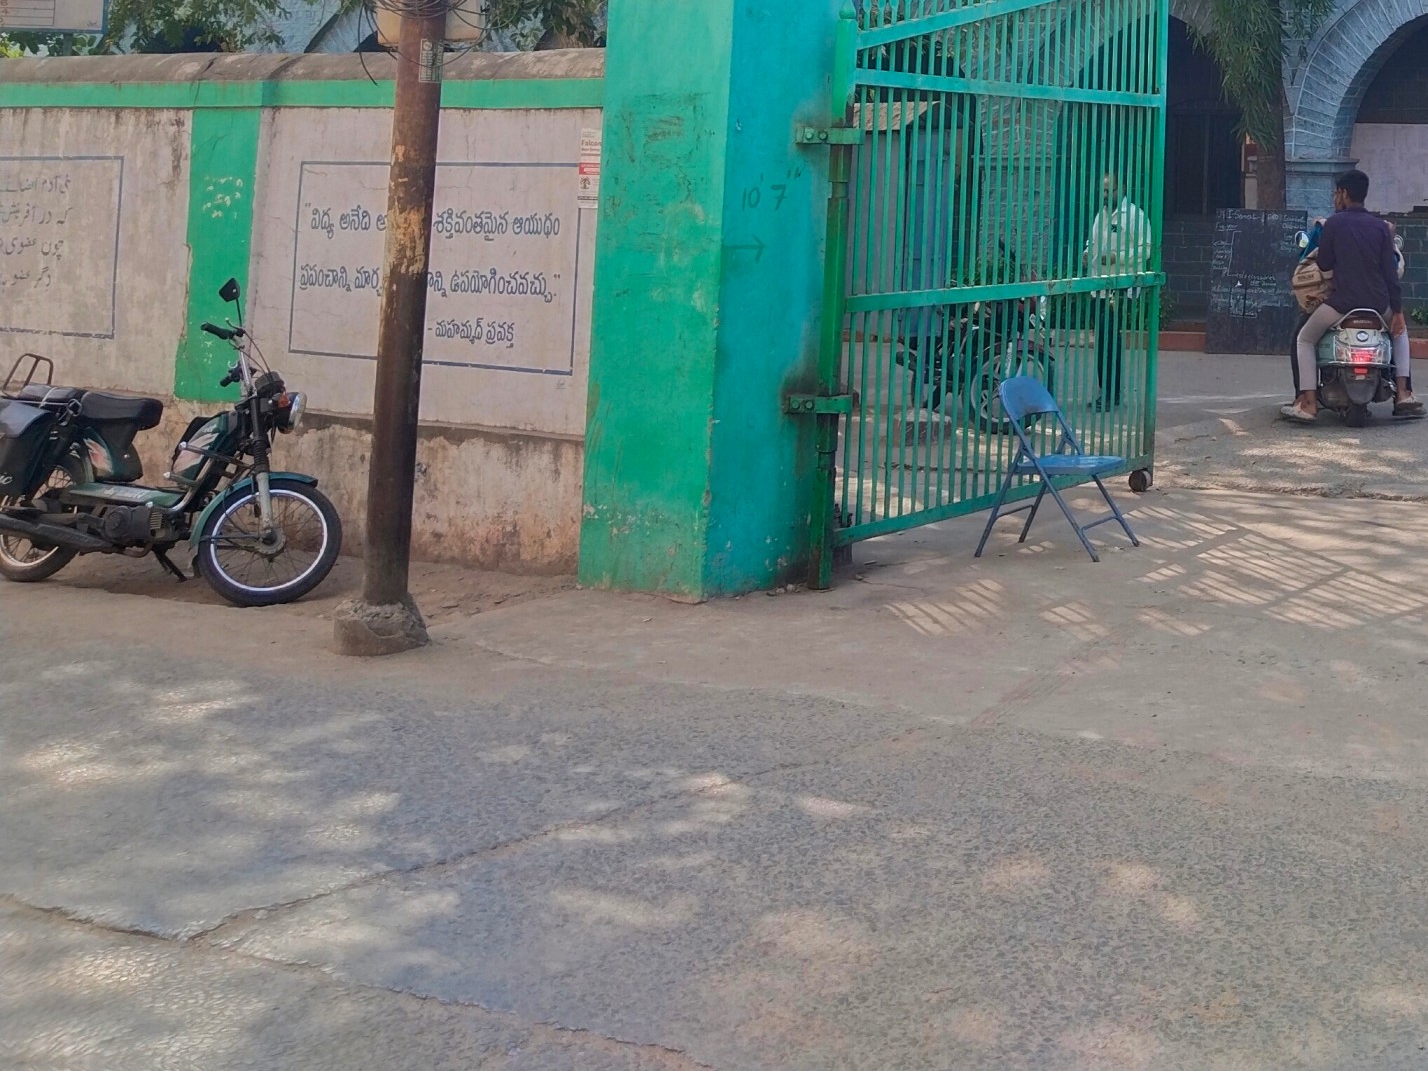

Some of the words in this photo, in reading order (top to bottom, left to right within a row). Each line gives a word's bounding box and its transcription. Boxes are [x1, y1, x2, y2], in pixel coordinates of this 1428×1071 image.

[339, 206, 371, 231] అనేది
[512, 213, 560, 240] ఆయుధం
[299, 264, 351, 293] ప్రపంచాన్ని
[435, 317, 484, 344] మహమ్మద్
[485, 322, 515, 348] ప్రవక్త
